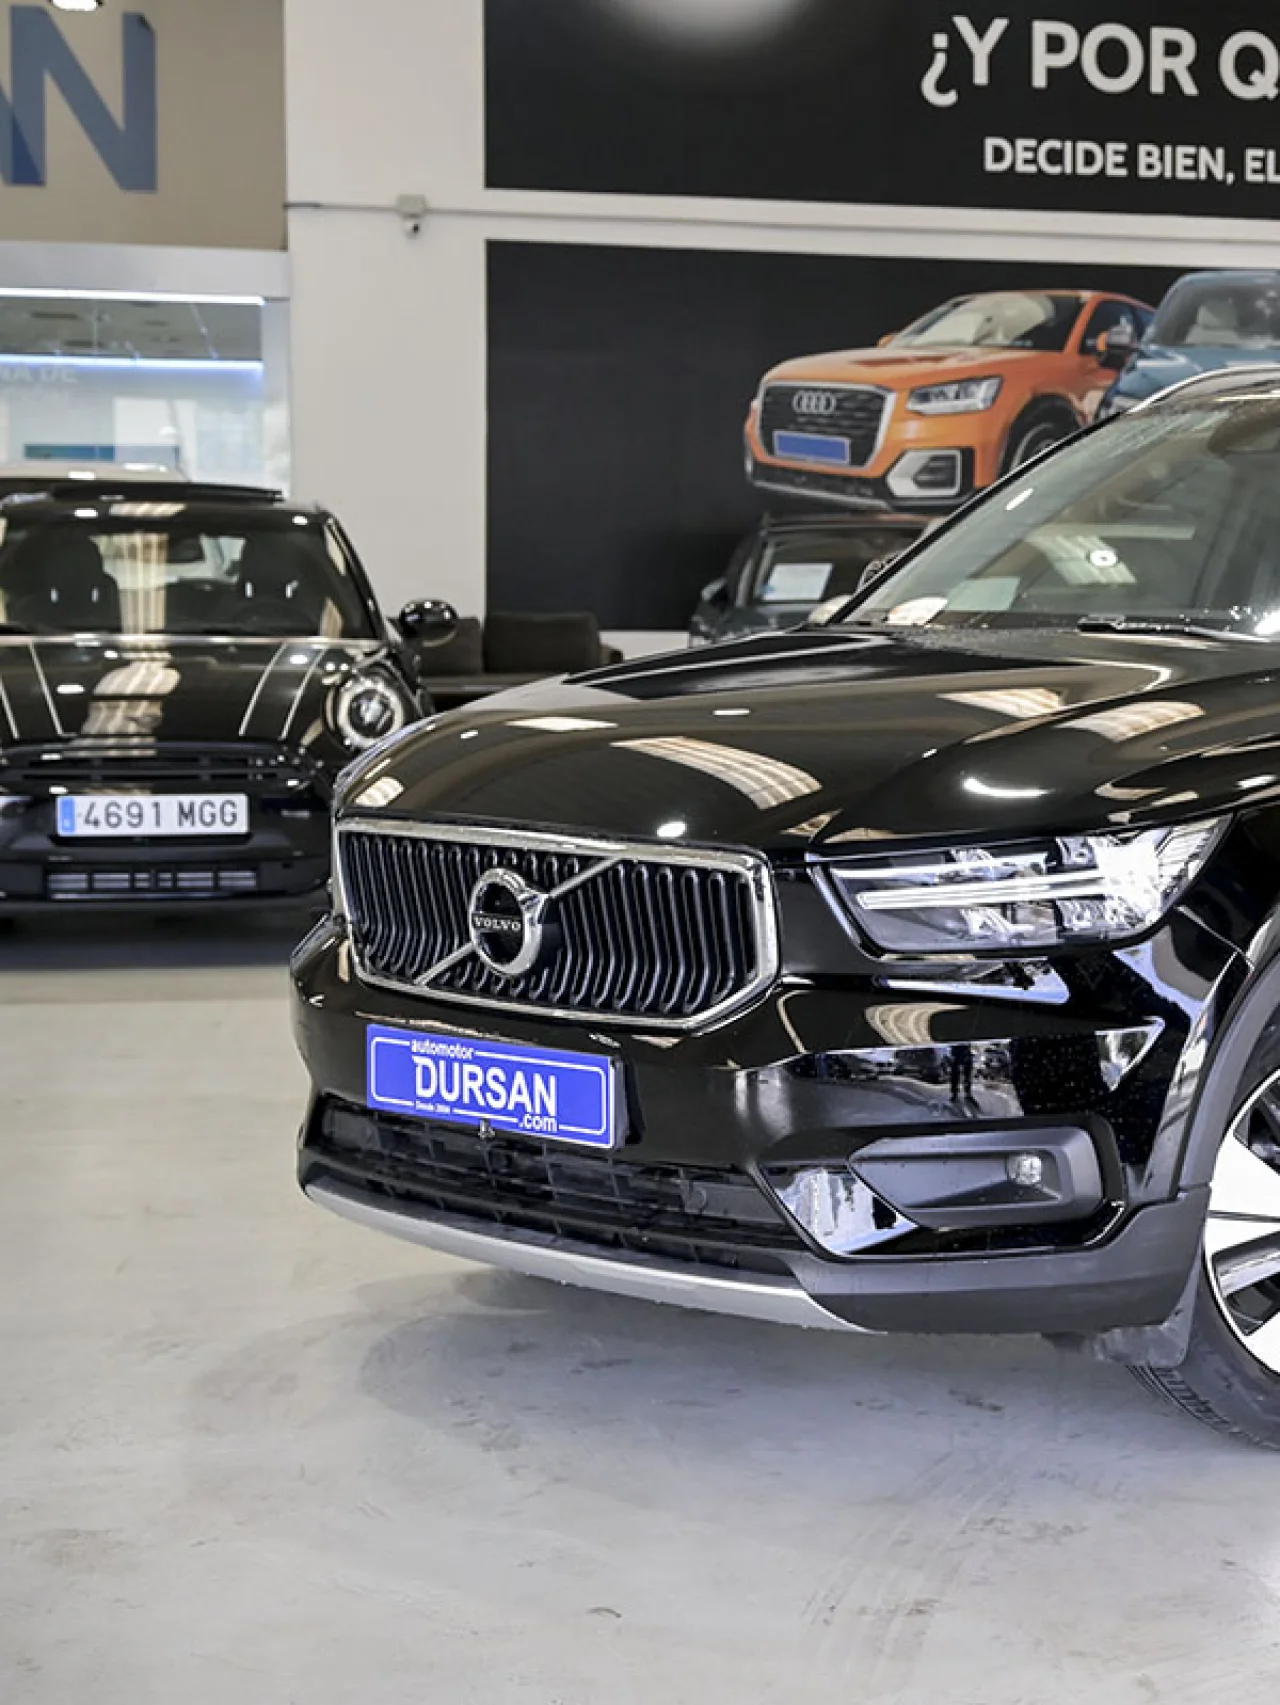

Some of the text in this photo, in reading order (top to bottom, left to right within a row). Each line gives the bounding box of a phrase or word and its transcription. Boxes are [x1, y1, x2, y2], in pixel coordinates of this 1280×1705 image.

[921, 15, 1009, 107] ¿Y
[1031, 20, 1199, 96] POR
[983, 137, 1128, 177] DECIDE
[1137, 144, 1235, 185] BIEN,
[84, 800, 238, 828] 4691 MGG
[474, 916, 521, 931] VOLVO
[411, 1038, 475, 1060] automotor
[411, 1055, 557, 1117] DURSAN
[518, 1113, 558, 1132] .com
